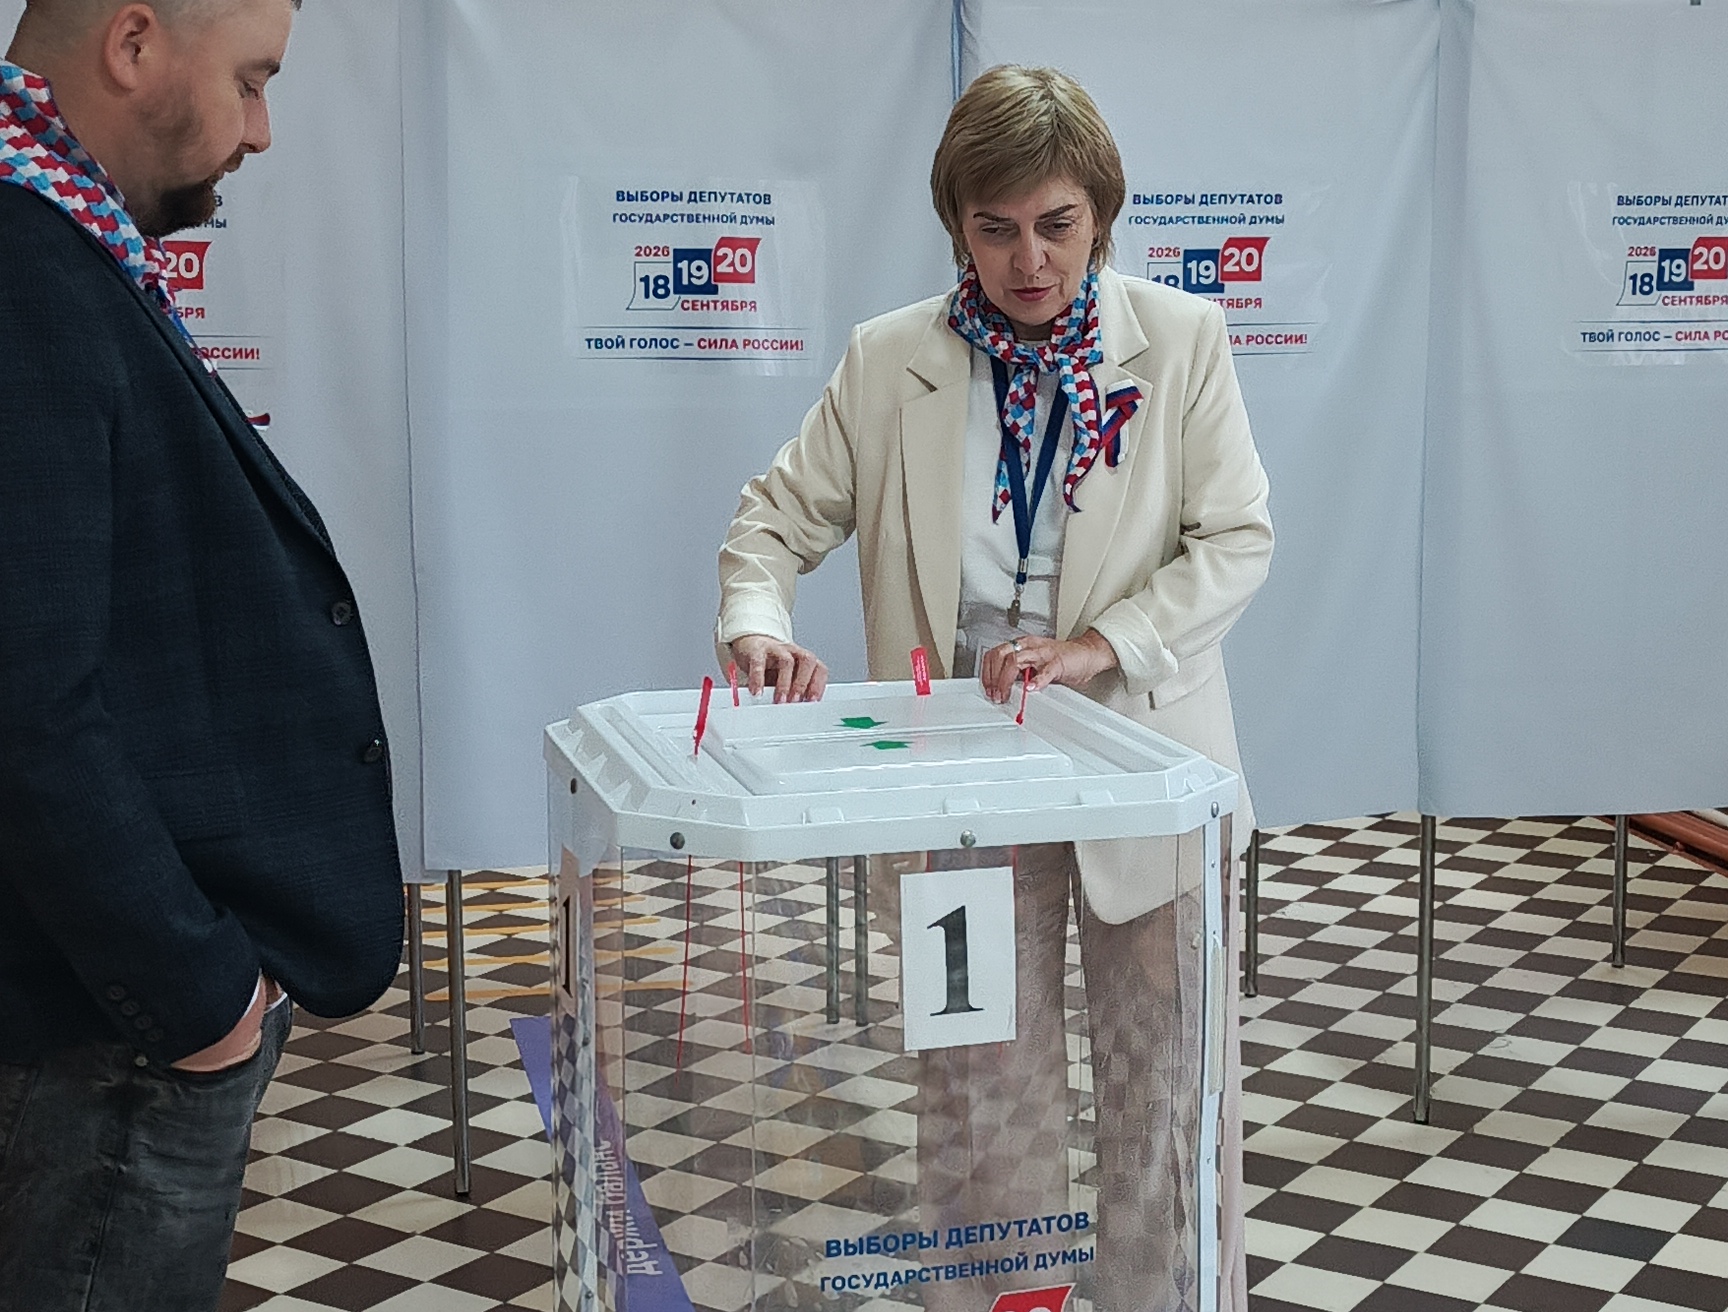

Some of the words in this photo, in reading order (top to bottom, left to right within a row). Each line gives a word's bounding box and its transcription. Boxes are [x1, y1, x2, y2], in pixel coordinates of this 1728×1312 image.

[616, 190, 683, 202] ВЫБОРЫ
[687, 191, 771, 205] ДЕПУТАТОВ
[1132, 194, 1195, 205] ВЫБОРЫ
[1198, 193, 1283, 206] ДЕПУТАТОВ
[1617, 195, 1672, 206] ВЫБОРЫ
[1674, 195, 1728, 208] ДЕПУТАТ
[612, 212, 737, 225] ГОСУДАРСТВЕННОЙ
[740, 215, 775, 226] ДУМЫ
[1128, 213, 1246, 226] ГОСУДАРСТВЕННОЙ
[1249, 215, 1285, 226] ДУМЫ
[1612, 213, 1713, 226] ГОСУДАРСТВЕННОЙ
[634, 245, 670, 257] 2026
[1148, 247, 1181, 258] 2026
[1627, 246, 1656, 257] 2026
[165, 251, 200, 278] 20
[1187, 260, 1216, 285] 19
[1223, 247, 1259, 272] 20
[1629, 273, 1654, 296] 18
[1661, 258, 1687, 283] 19
[1692, 246, 1726, 271] 20
[639, 274, 671, 299] 18
[677, 260, 709, 286] 19
[716, 248, 752, 273] 20
[681, 299, 757, 312] СЕНТЯБРЯ
[1207, 297, 1262, 309] ТЯБРЯ
[1661, 295, 1728, 306] СЕНТЯБРЯ
[1246, 334, 1307, 345] РОССИИ!
[1580, 329, 1615, 343] ТВОЙ
[1618, 331, 1661, 342] ГОЛОС
[1675, 330, 1710, 341] СИЛА
[585, 335, 625, 350] ТВОЙ
[629, 338, 680, 350] ГОЛОС
[697, 338, 739, 350] СИЛА
[742, 339, 804, 351] РОССИИ!
[927, 905, 984, 1016] 1
[825, 1229, 939, 1258] ВЫБОРЫ
[946, 1211, 1090, 1248] ДЕПУТАТОВ
[820, 1252, 1028, 1292] ГОСУДАРСТВЕННОЙ
[1034, 1247, 1094, 1273] ДУМЫ
